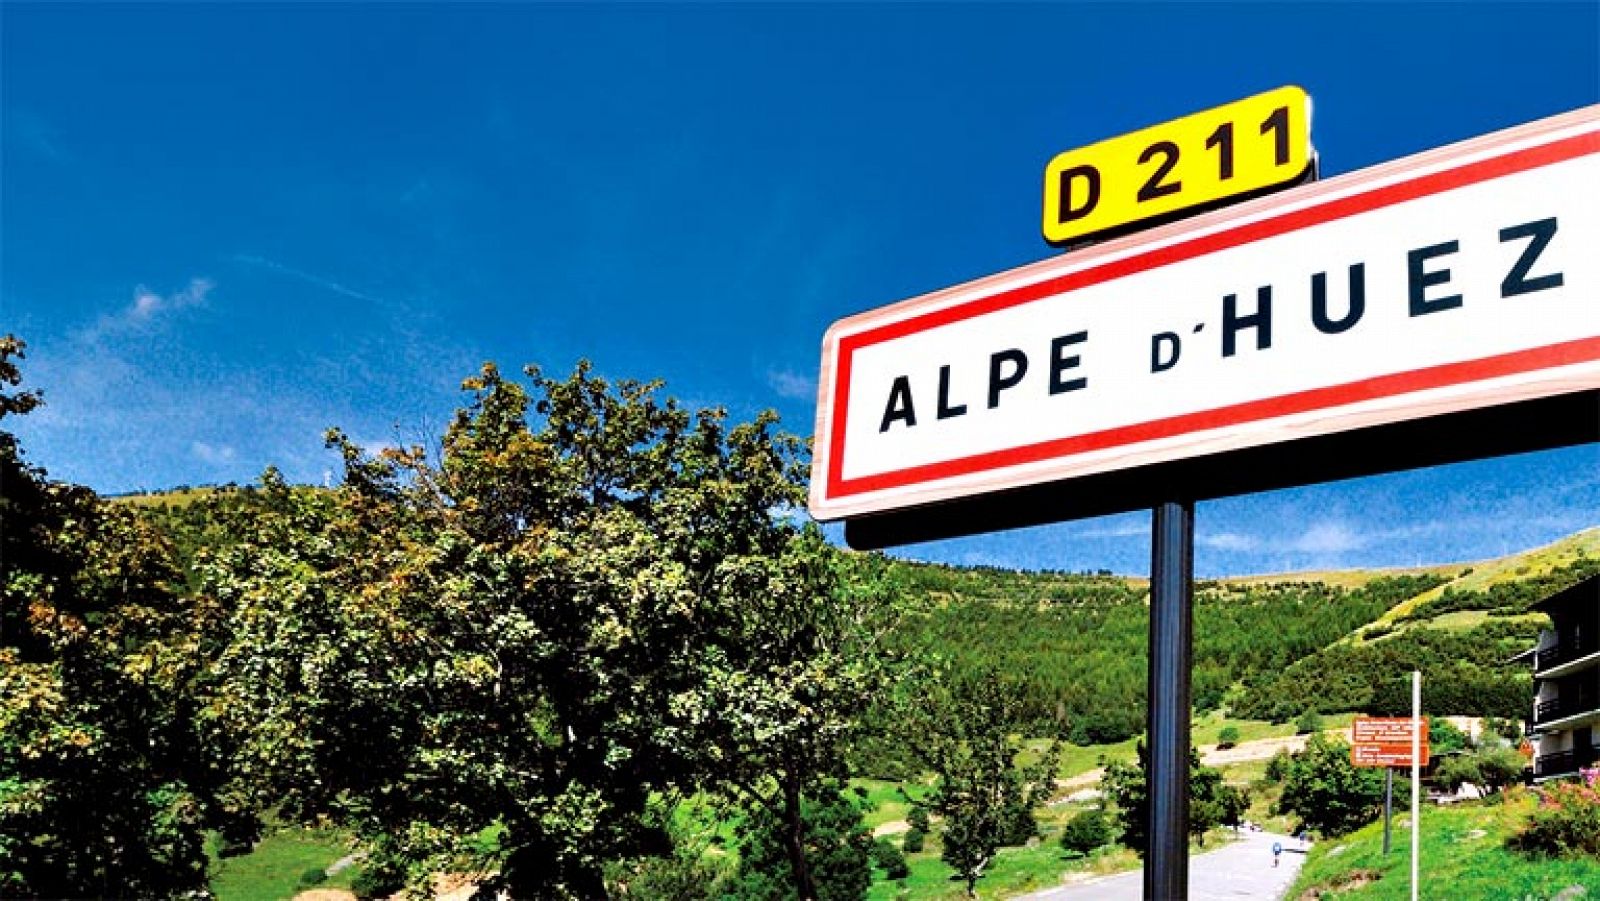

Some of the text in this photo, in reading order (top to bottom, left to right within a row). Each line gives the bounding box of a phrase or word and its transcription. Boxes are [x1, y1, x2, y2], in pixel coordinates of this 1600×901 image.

[1057, 105, 1291, 224] D 211
[878, 329, 1090, 433] ALPE
